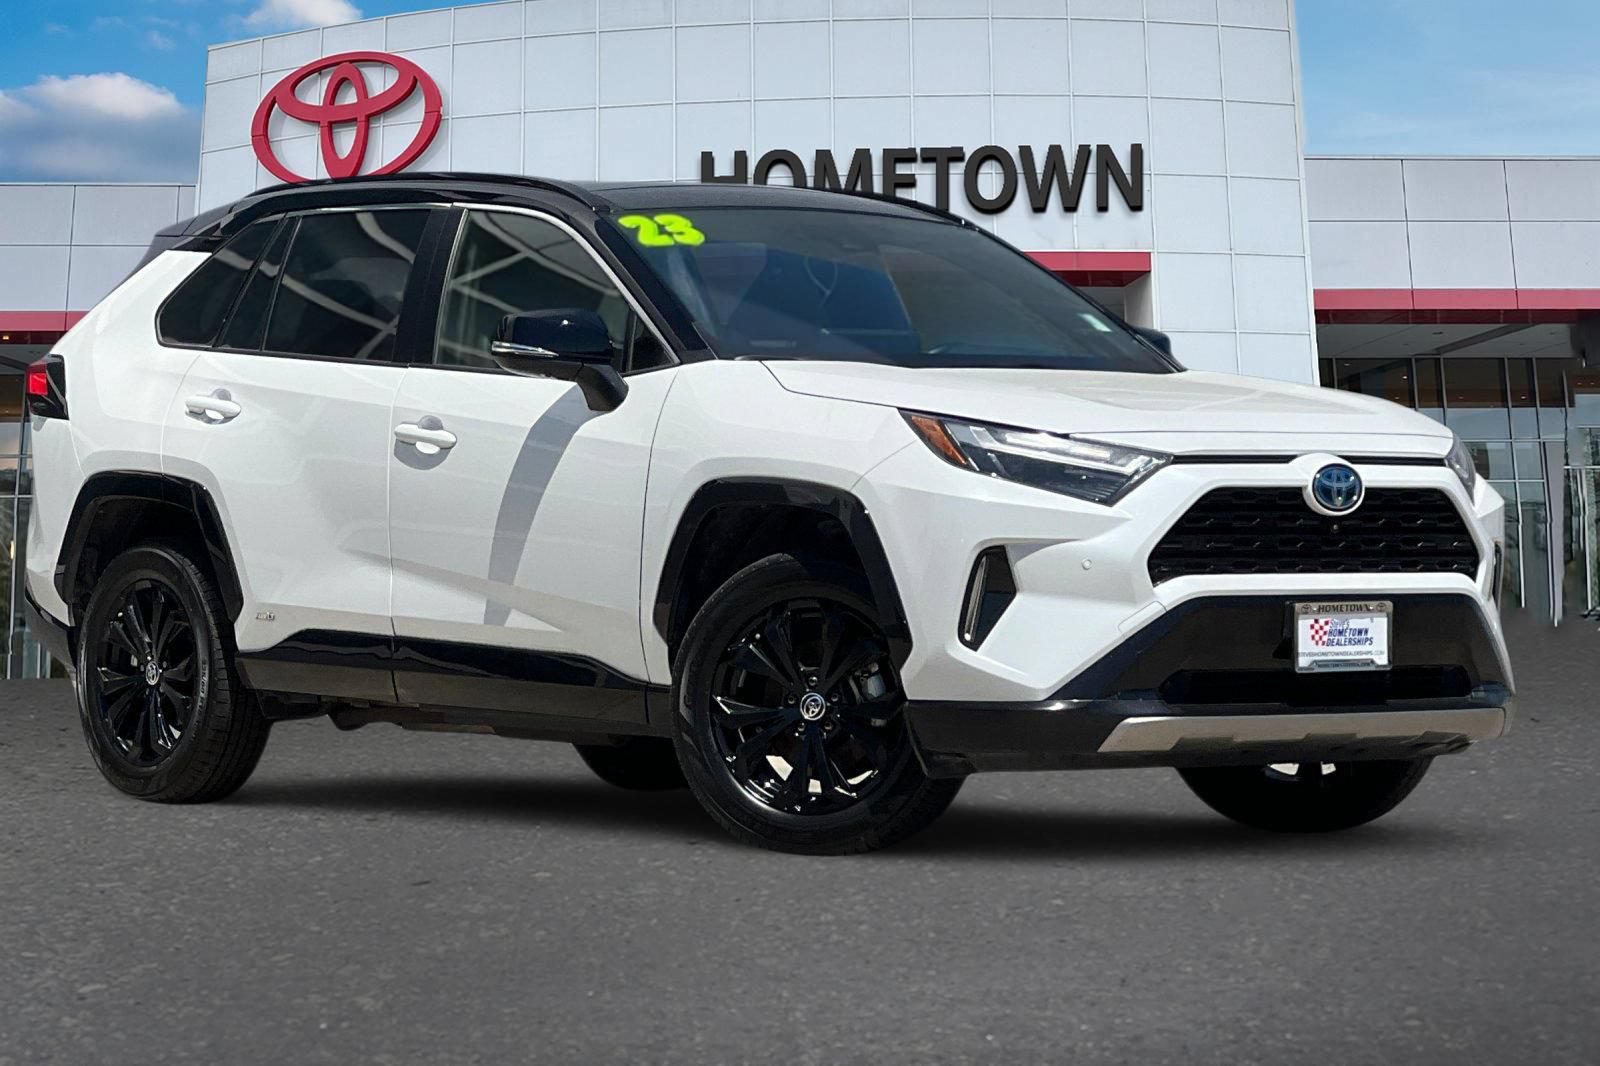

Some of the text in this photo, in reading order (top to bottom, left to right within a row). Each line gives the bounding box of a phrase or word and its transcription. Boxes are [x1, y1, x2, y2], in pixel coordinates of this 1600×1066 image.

[700, 143, 1144, 214] HOMETOWN
[618, 213, 705, 247] 23
[1326, 636, 1374, 647] DEALERSHIPS
[1328, 627, 1369, 637] HOMETOWN
